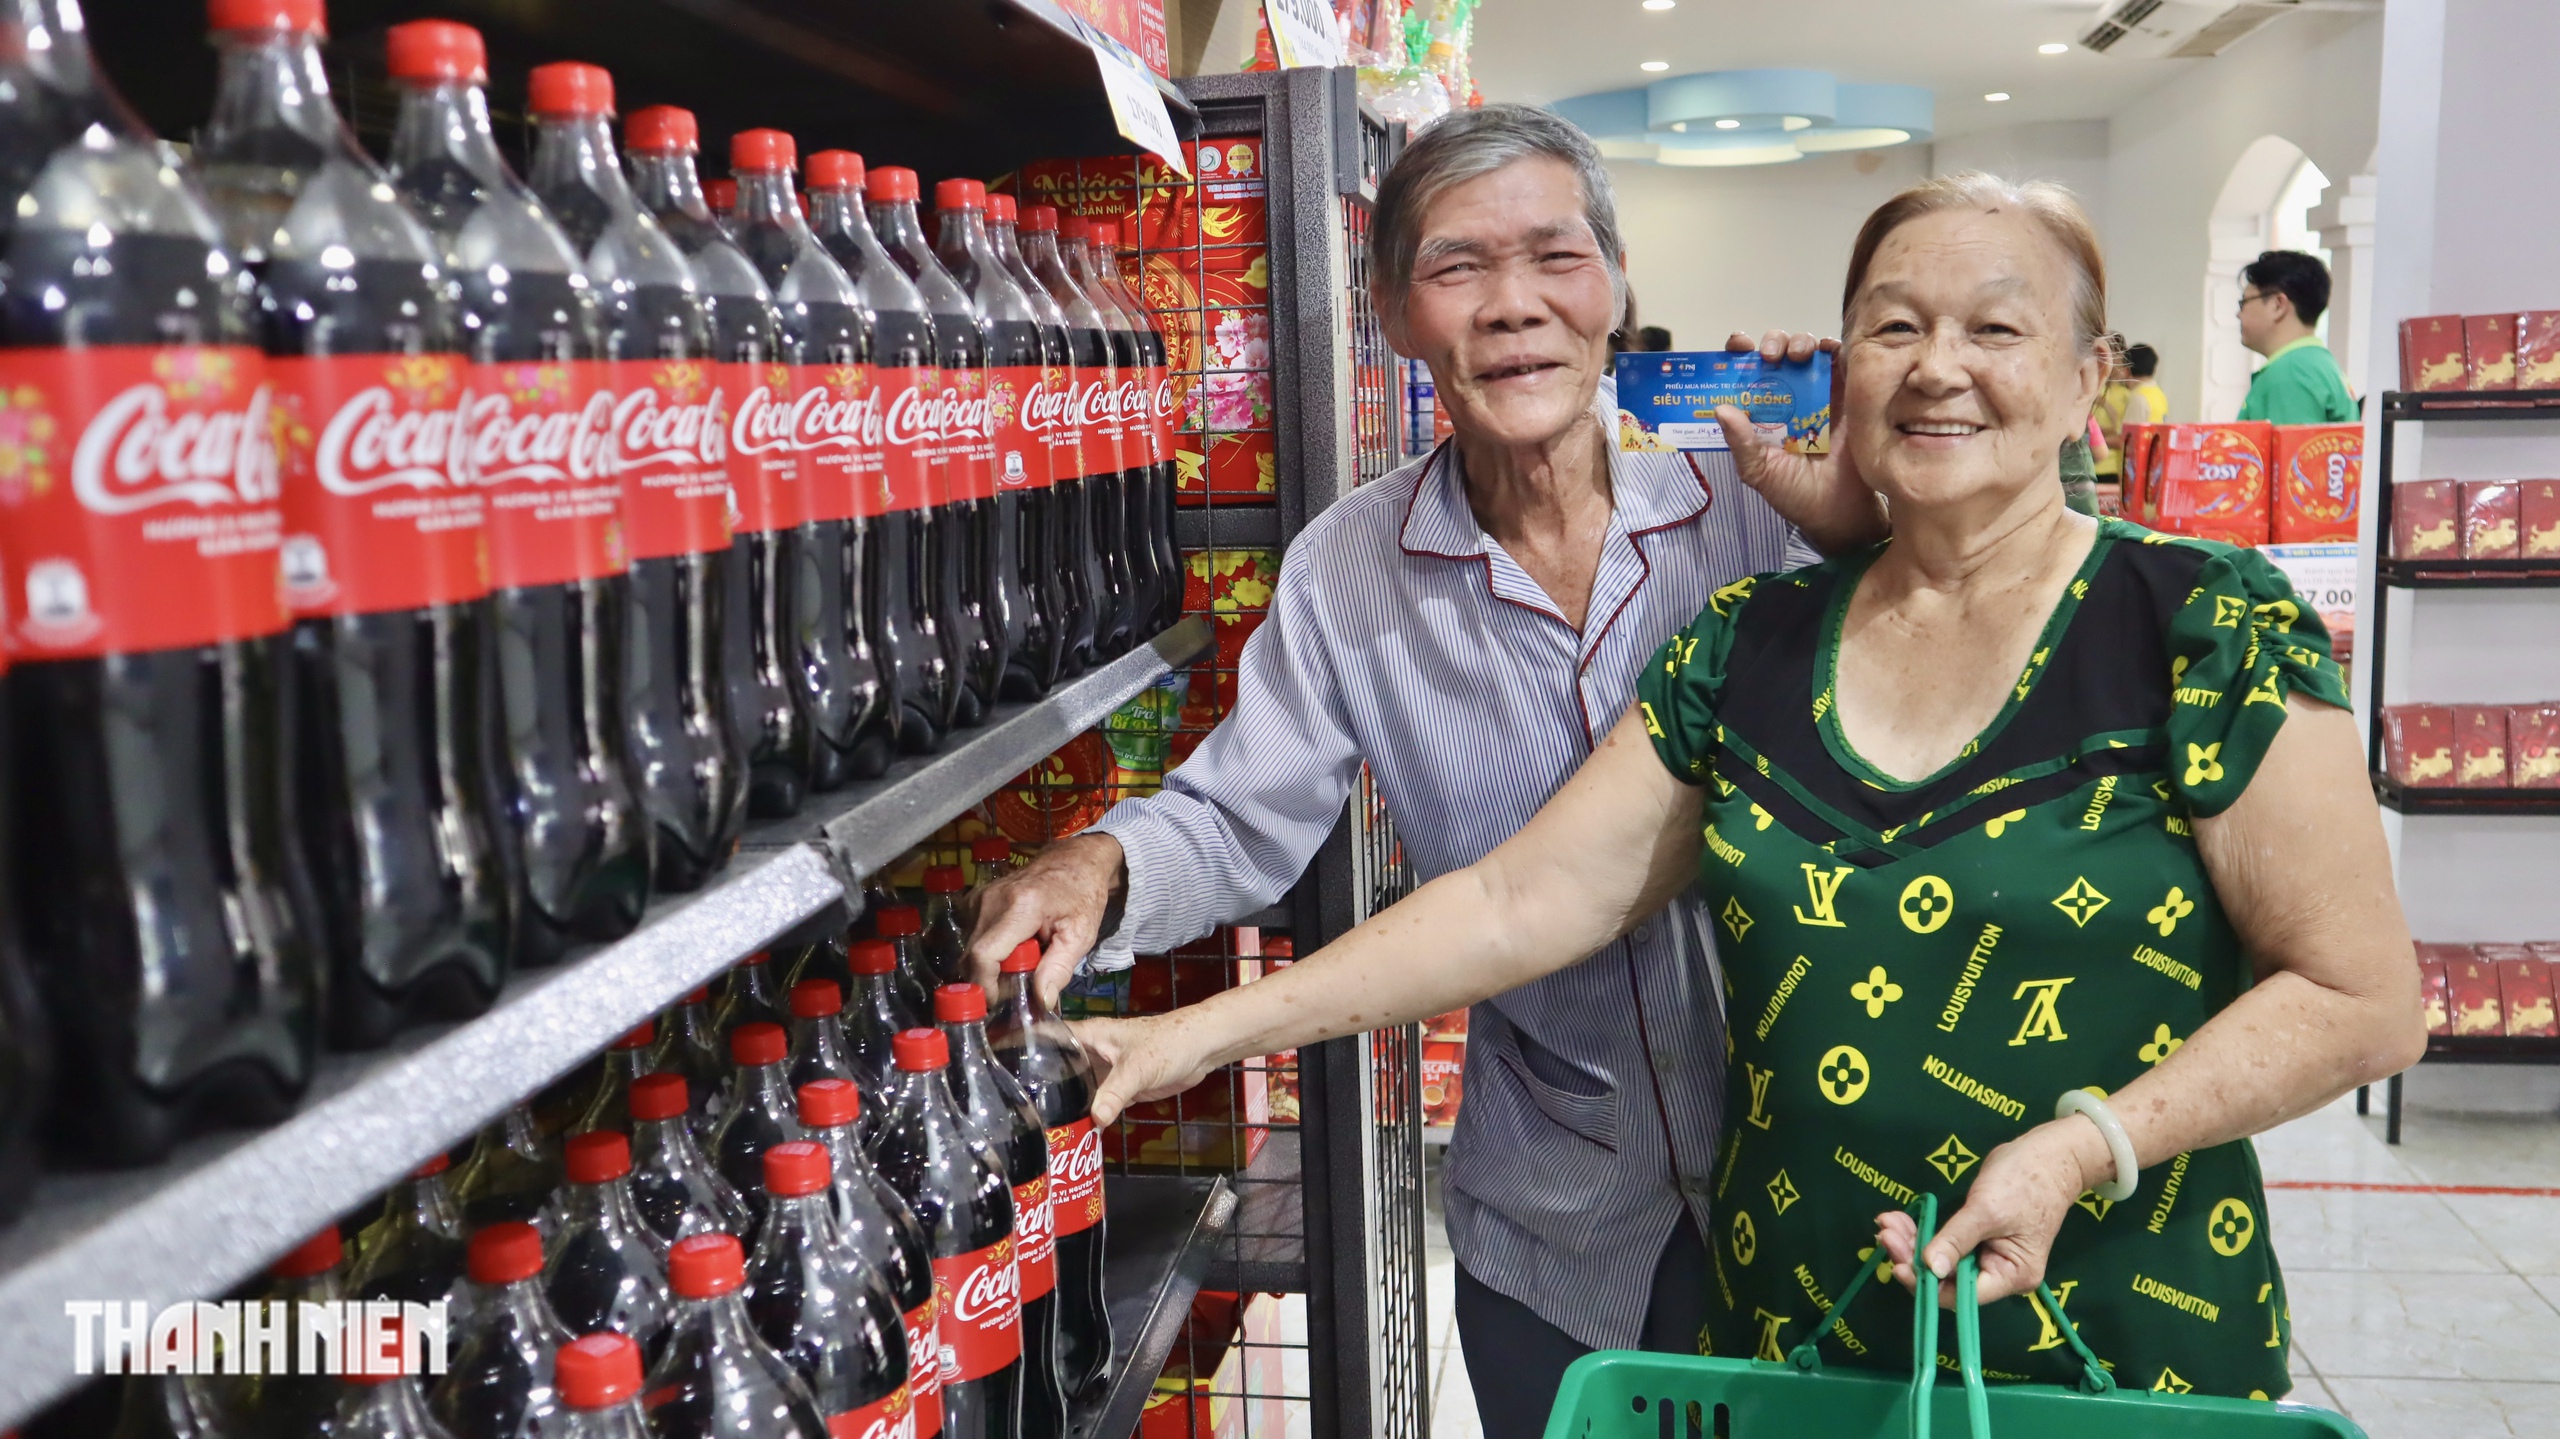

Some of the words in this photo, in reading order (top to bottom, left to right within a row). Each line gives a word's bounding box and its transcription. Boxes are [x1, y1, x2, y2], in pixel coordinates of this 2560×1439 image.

[1033, 172, 1126, 207] Nước
[1072, 203, 1103, 215] NGÂN
[1665, 382, 1683, 390] PHIẾU
[1700, 381, 1719, 389] HÀNG
[1653, 392, 1681, 405] SIÊU
[1685, 395, 1706, 407] THỊ
[1710, 395, 1737, 405] MINI
[1740, 391, 1751, 406] 0
[1754, 391, 1792, 405] ĐỒNG
[2199, 462, 2241, 481] COSY
[2328, 452, 2348, 501] COSY
[2294, 589, 2357, 606] 7.00
[1111, 713, 1130, 730] Bí
[1131, 705, 1155, 720] Trà
[2132, 944, 2202, 990] LOUISVUITTON
[1936, 923, 2003, 1032] LOUISVUITTON
[1755, 955, 1812, 1041] LOUISVUITTON
[1422, 1063, 1460, 1074] SCAFE
[1922, 1055, 2026, 1121] LOUISVUITTON
[1059, 1188, 1067, 1198] VỊ
[1068, 1180, 1092, 1195] NGUYÊN
[2132, 1274, 2219, 1322] LOUISVUITTON
[1794, 1264, 1867, 1355] LOUISUITTON
